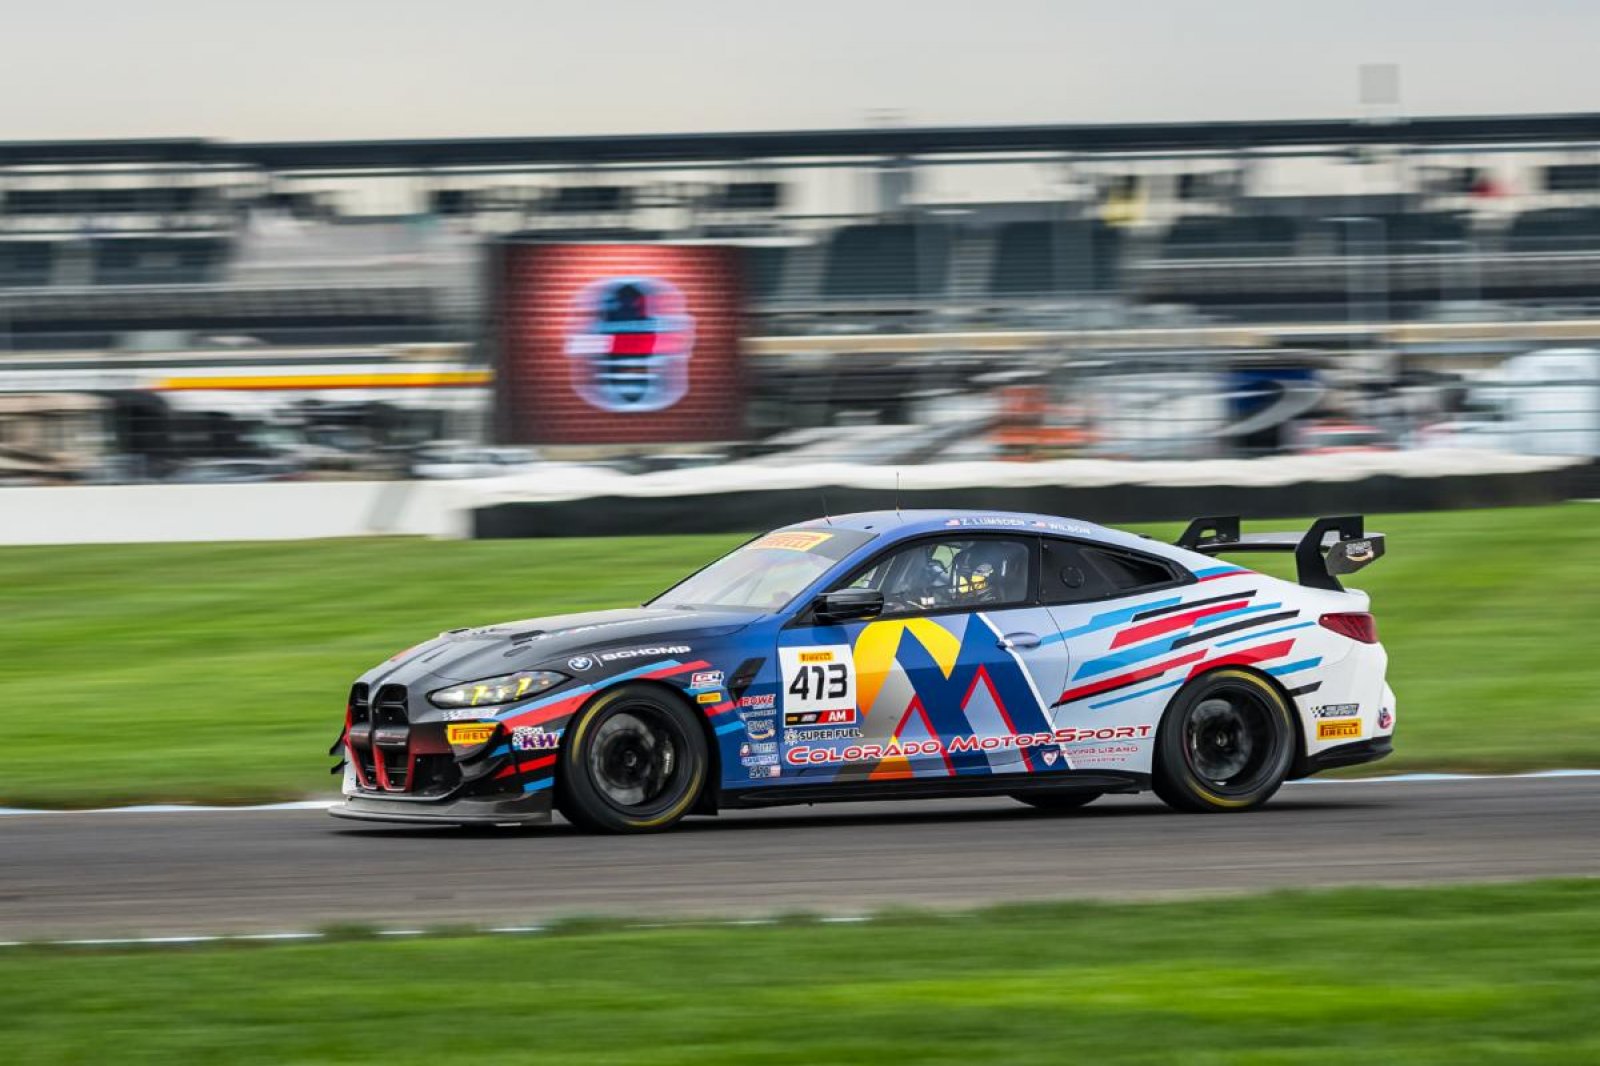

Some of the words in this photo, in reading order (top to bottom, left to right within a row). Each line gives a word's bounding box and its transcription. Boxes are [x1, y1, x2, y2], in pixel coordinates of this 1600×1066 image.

[601, 646, 691, 661] SCHOMP
[828, 711, 847, 722] AM
[800, 732, 833, 740] SUPER
[1320, 723, 1358, 737] PIRELLI
[522, 733, 558, 749] KW
